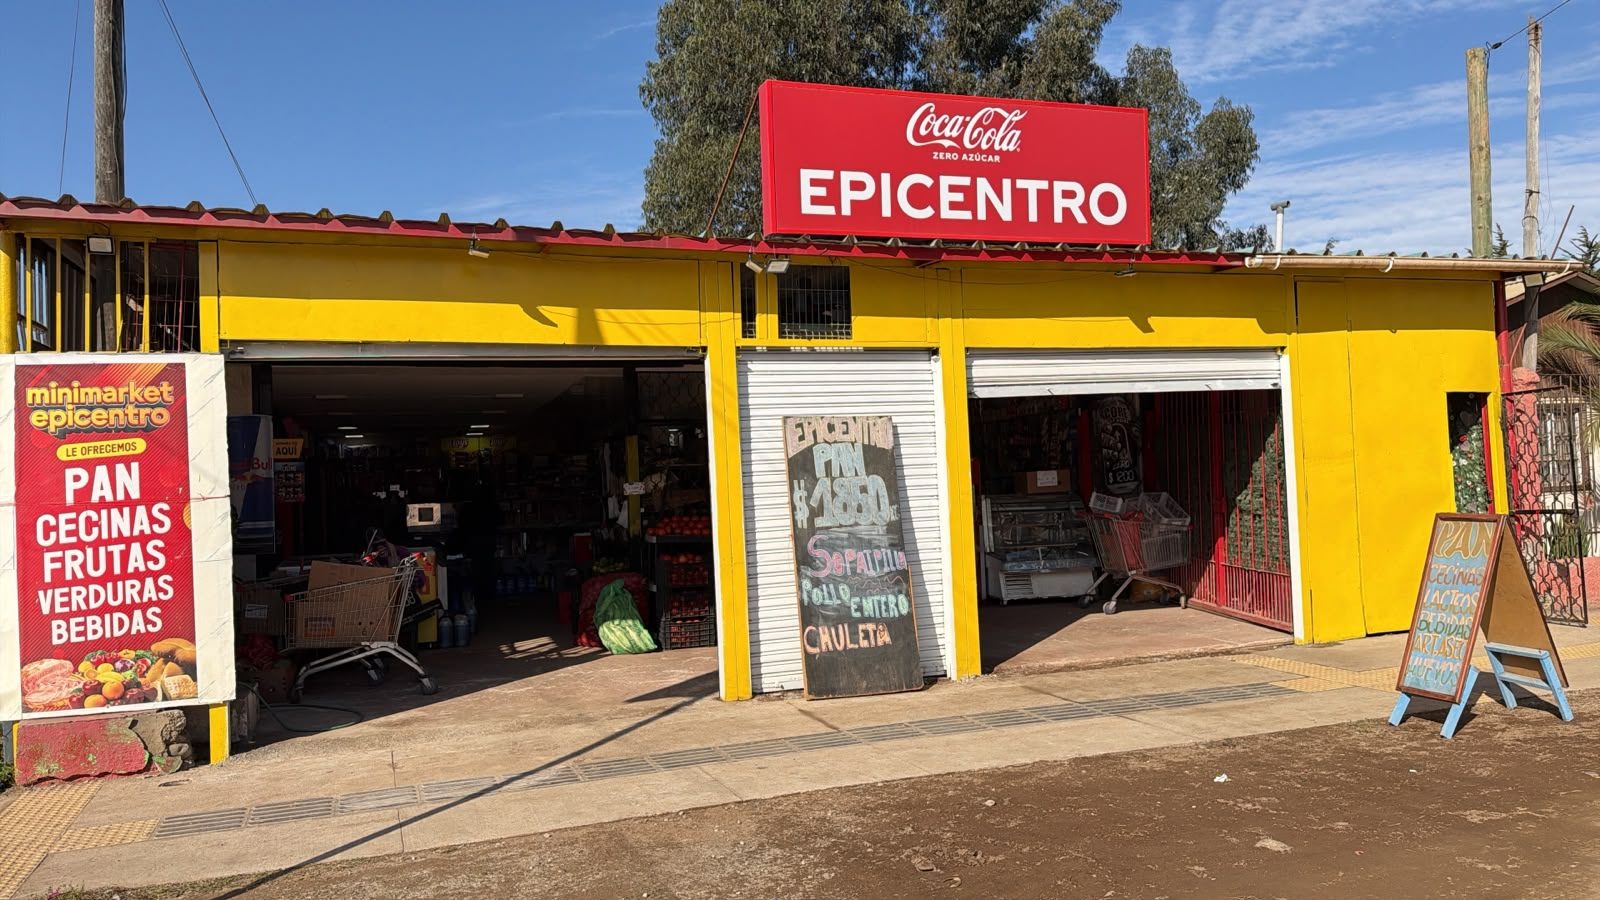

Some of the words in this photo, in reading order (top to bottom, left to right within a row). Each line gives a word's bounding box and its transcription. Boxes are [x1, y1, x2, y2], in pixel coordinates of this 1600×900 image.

[906, 102, 1028, 152] Coca-Cola
[932, 151, 959, 161] ZERO
[961, 152, 1001, 163] AZÚCAR
[800, 168, 1127, 226] EPICENTRO
[27, 381, 174, 407] minimarket
[30, 404, 171, 434] epicentro
[786, 415, 893, 458] EPICENTRO
[65, 447, 77, 458] LE
[80, 441, 137, 456] OFRECEMOS
[812, 442, 866, 480] PAN
[64, 461, 141, 506] PAN
[36, 502, 171, 547] CECINAS
[1433, 520, 1494, 559] PAN
[43, 539, 167, 583] FRUTAS
[1428, 563, 1486, 586] CECINAS
[37, 574, 174, 616] VERDURAS
[850, 593, 909, 619] ENTERO
[51, 606, 163, 646] BEBIDAS
[803, 622, 892, 655] CHULETA
